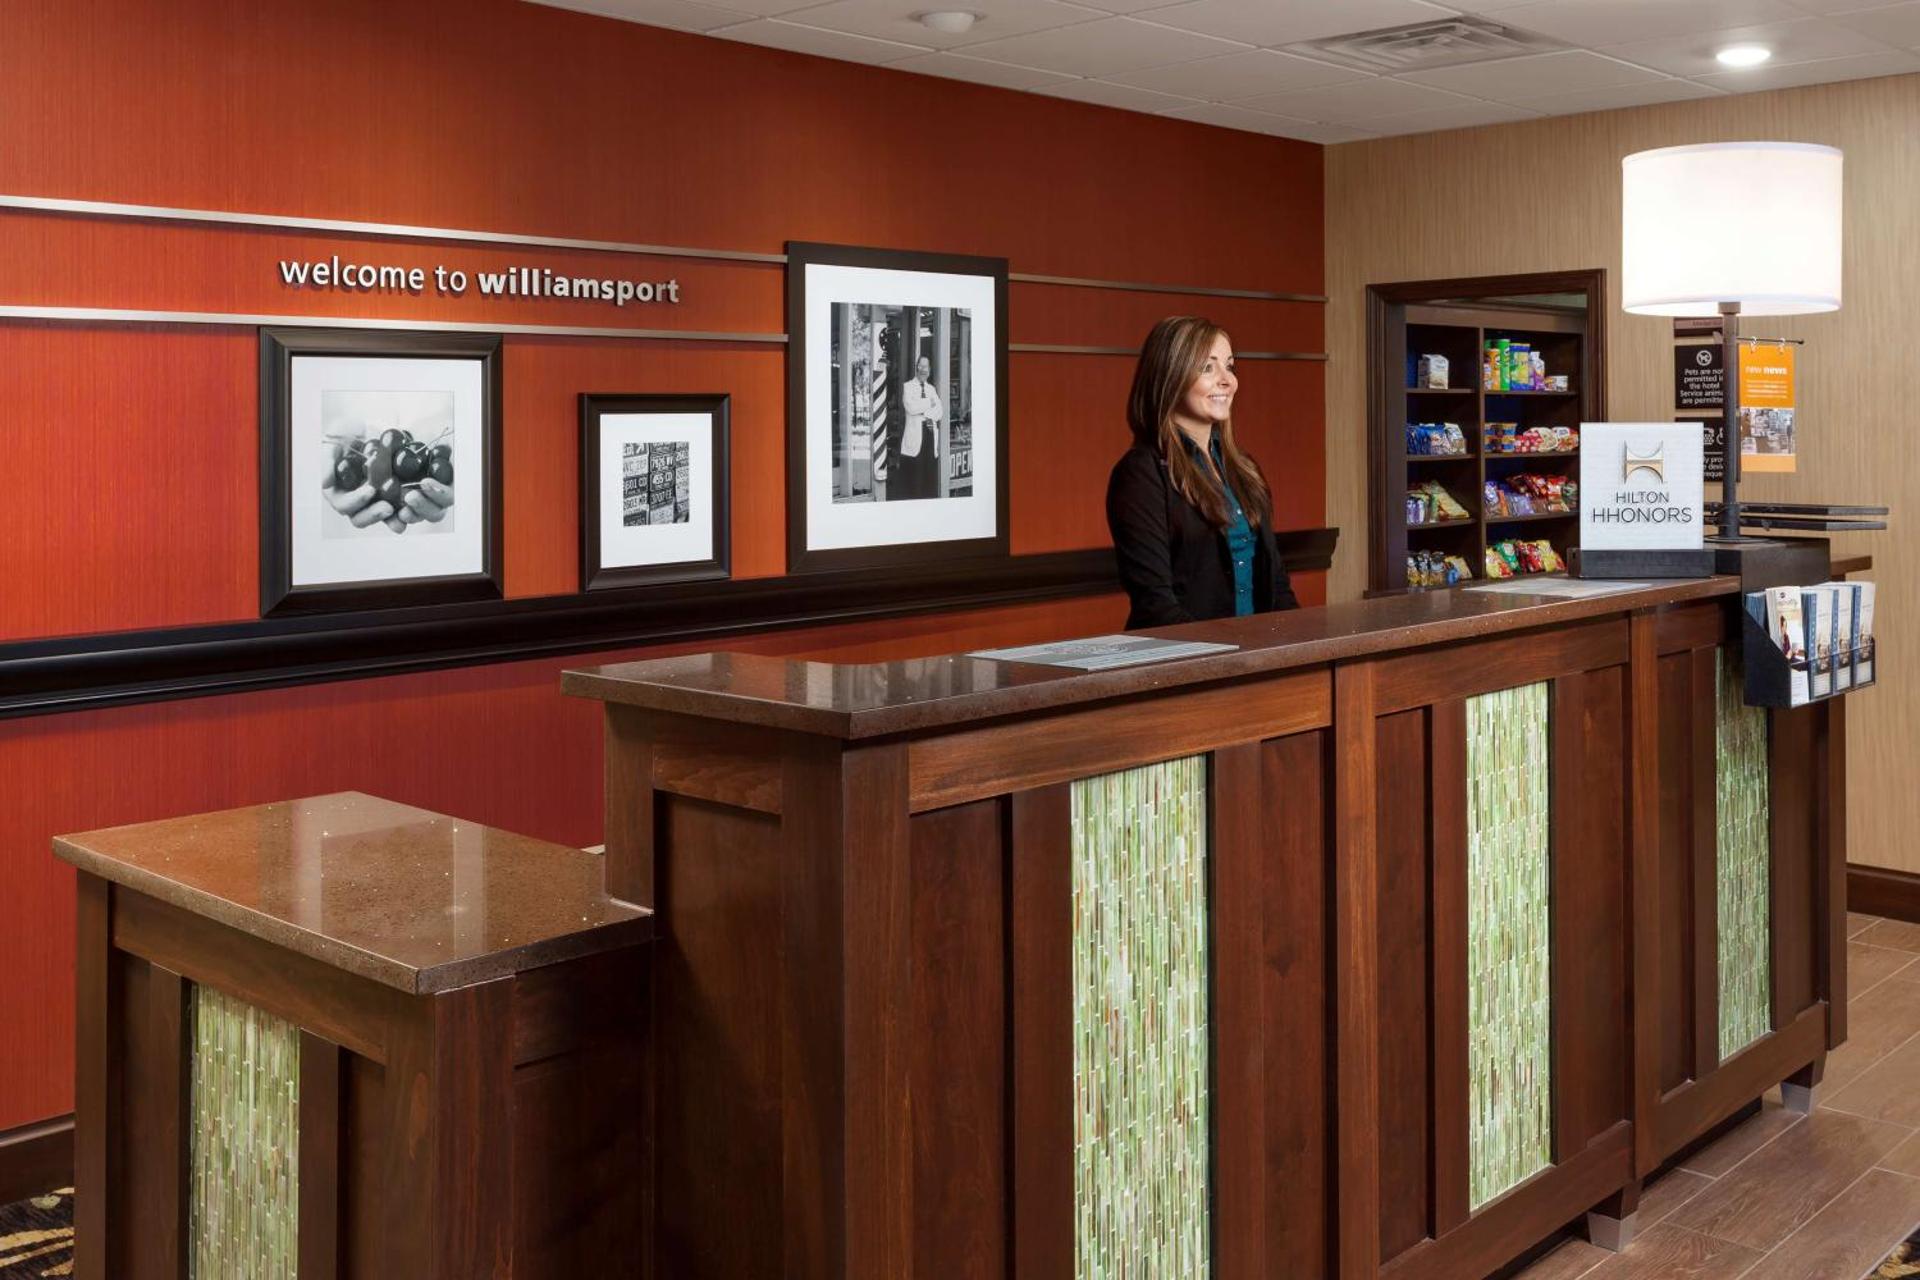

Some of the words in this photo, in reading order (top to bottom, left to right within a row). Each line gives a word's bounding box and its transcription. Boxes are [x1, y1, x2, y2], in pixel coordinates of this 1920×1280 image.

[280, 255, 424, 291] welcome
[435, 265, 467, 293] to
[478, 266, 680, 306] williamsport
[1684, 368, 1699, 376] Pets
[1683, 374, 1717, 384] permitted
[1615, 491, 1670, 504] HILTON
[1592, 507, 1693, 523] HHONORS
